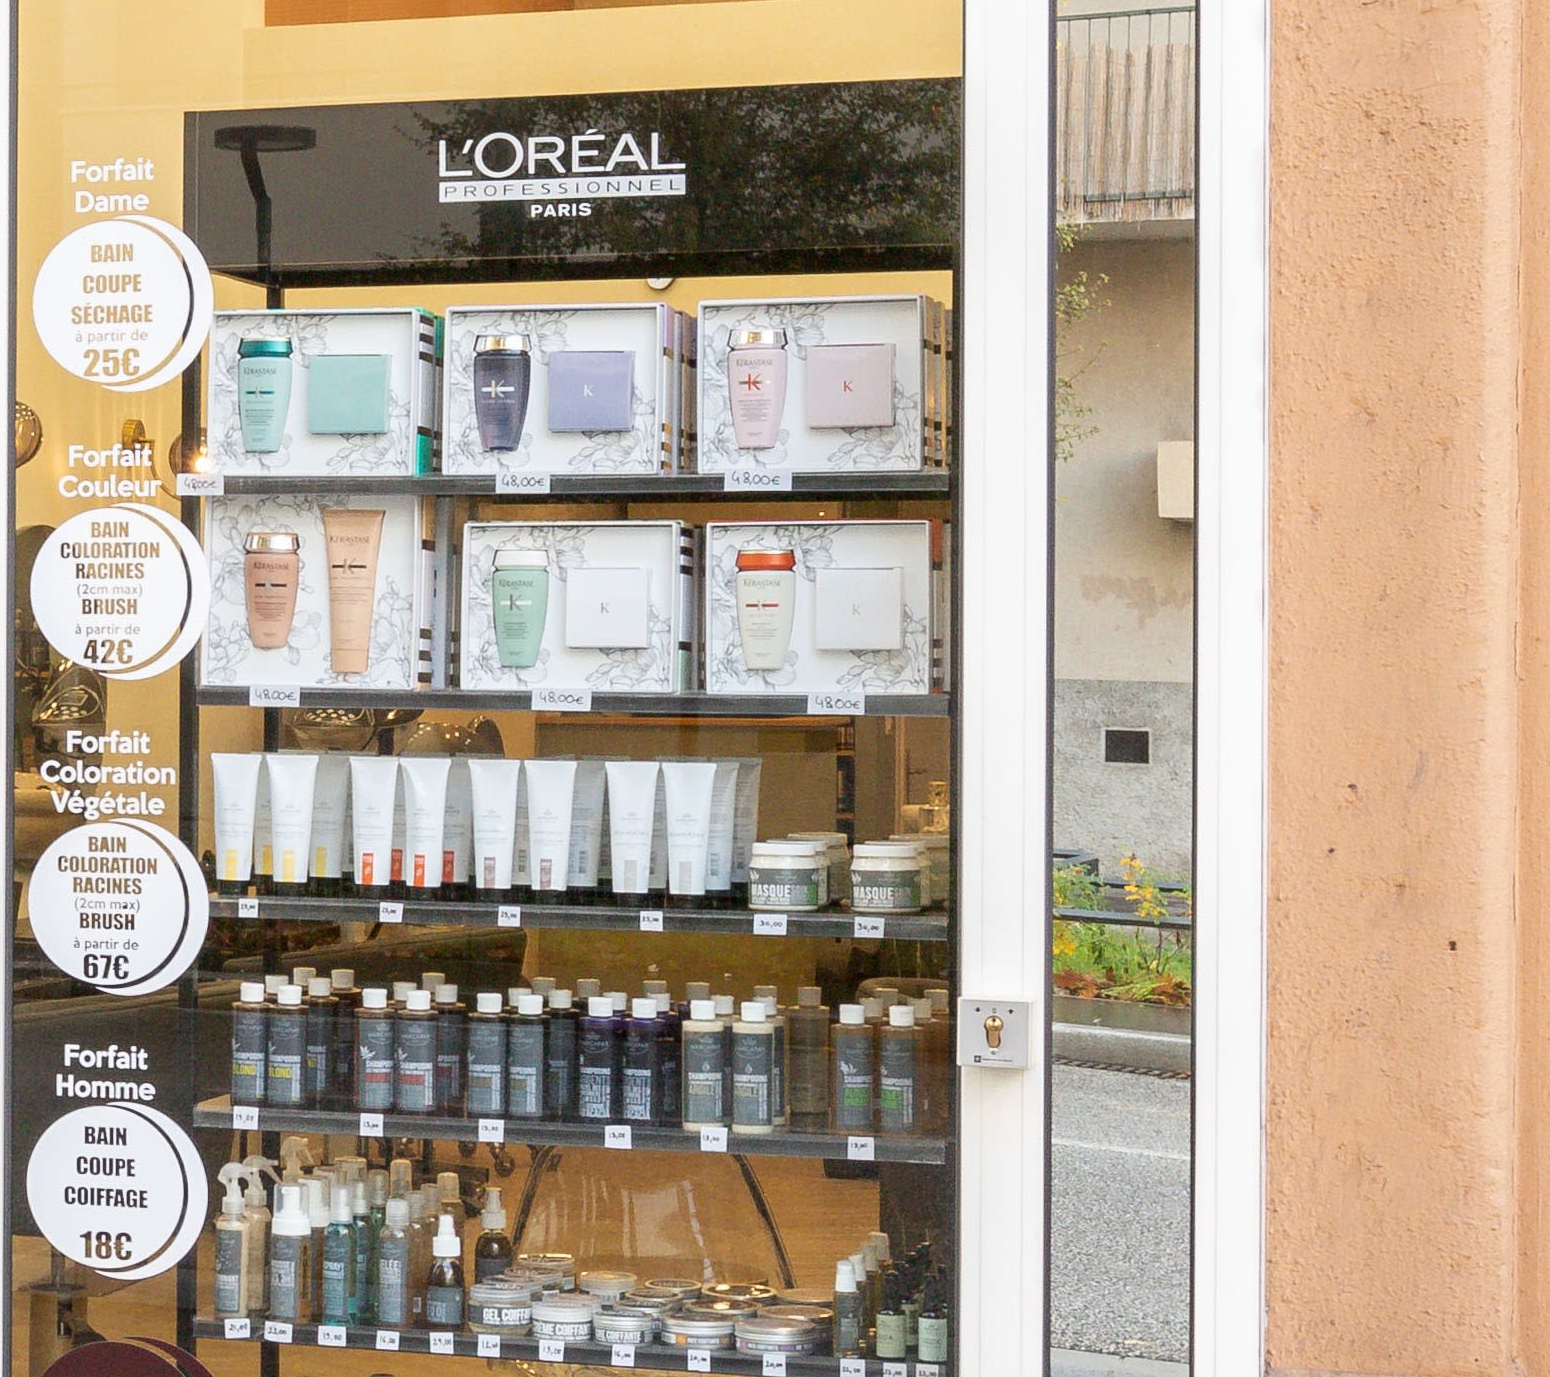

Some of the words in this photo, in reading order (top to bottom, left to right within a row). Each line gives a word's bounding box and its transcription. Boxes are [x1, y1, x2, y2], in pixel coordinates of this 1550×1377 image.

[439, 129, 686, 179] L'ORÉAL
[70, 158, 154, 183] Forfait
[444, 178, 682, 199] PROFESSIONNEL
[74, 190, 149, 214] Dame
[530, 202, 592, 219] PARIS
[90, 243, 134, 263] BAIN
[82, 274, 142, 294] COUPE
[71, 302, 154, 325] SÉCHAGE
[75, 329, 84, 343] à
[87, 329, 127, 345] partir
[131, 328, 149, 341] de
[83, 348, 140, 377] 25€
[68, 443, 152, 468] Forfait
[58, 474, 162, 498] Couleur
[91, 521, 129, 538] BAIN
[60, 542, 161, 559] COLORATION
[75, 562, 145, 580] RACINES
[76, 583, 108, 597] (2cm
[112, 583, 143, 597] max)
[81, 598, 138, 615] BRUSH
[75, 623, 82, 635] à
[85, 623, 121, 639] partir
[124, 623, 140, 635] de
[83, 639, 133, 664] 42€
[66, 730, 150, 754] Forfait
[40, 760, 176, 785] Coloration
[50, 790, 165, 820] Végétale
[88, 836, 127, 853] BAIN
[57, 856, 158, 874] COLORATION
[73, 877, 142, 895] RACINES
[751, 884, 791, 899] MASQUE
[853, 885, 896, 900] MASQUE
[74, 897, 107, 912] (2cm
[109, 898, 140, 913] max)
[79, 913, 135, 930] BRUSH
[73, 937, 81, 949] à
[84, 938, 119, 953] partir
[123, 938, 139, 950] de
[83, 953, 129, 980] 67€
[64, 1043, 148, 1070] Forfait
[55, 1074, 156, 1100] Homme
[84, 1126, 127, 1146] BAIN
[76, 1156, 136, 1177] COUPE
[64, 1186, 148, 1209] COIFFAGE
[79, 1230, 133, 1260] 18€
